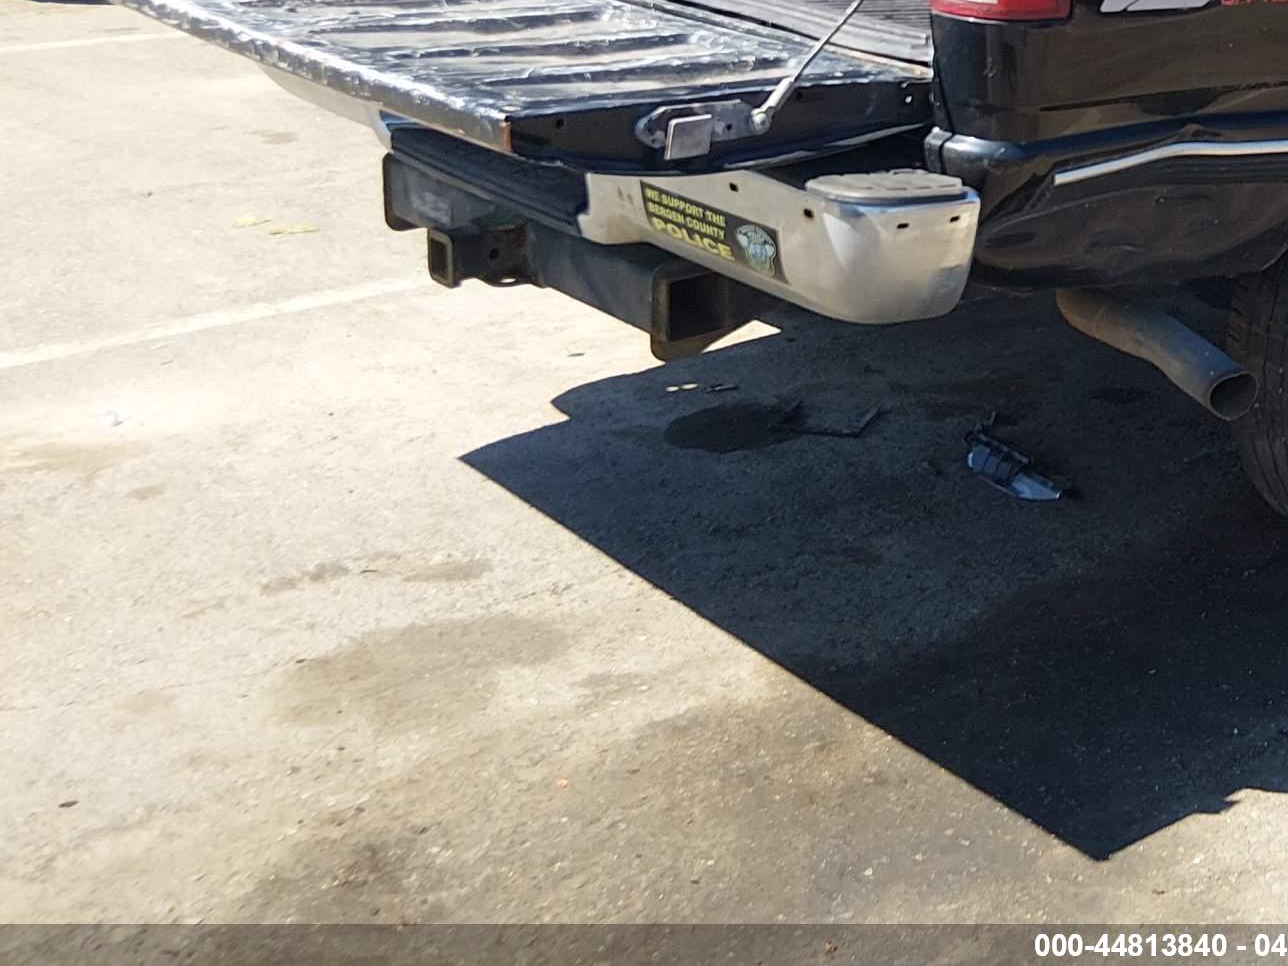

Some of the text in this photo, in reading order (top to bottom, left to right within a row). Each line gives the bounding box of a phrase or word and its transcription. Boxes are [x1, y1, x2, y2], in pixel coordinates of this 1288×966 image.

[645, 188, 726, 227] WE SUPPORT THE
[647, 201, 685, 224] BERGEN
[686, 218, 726, 240] COUNTY
[651, 218, 735, 260] POLICE
